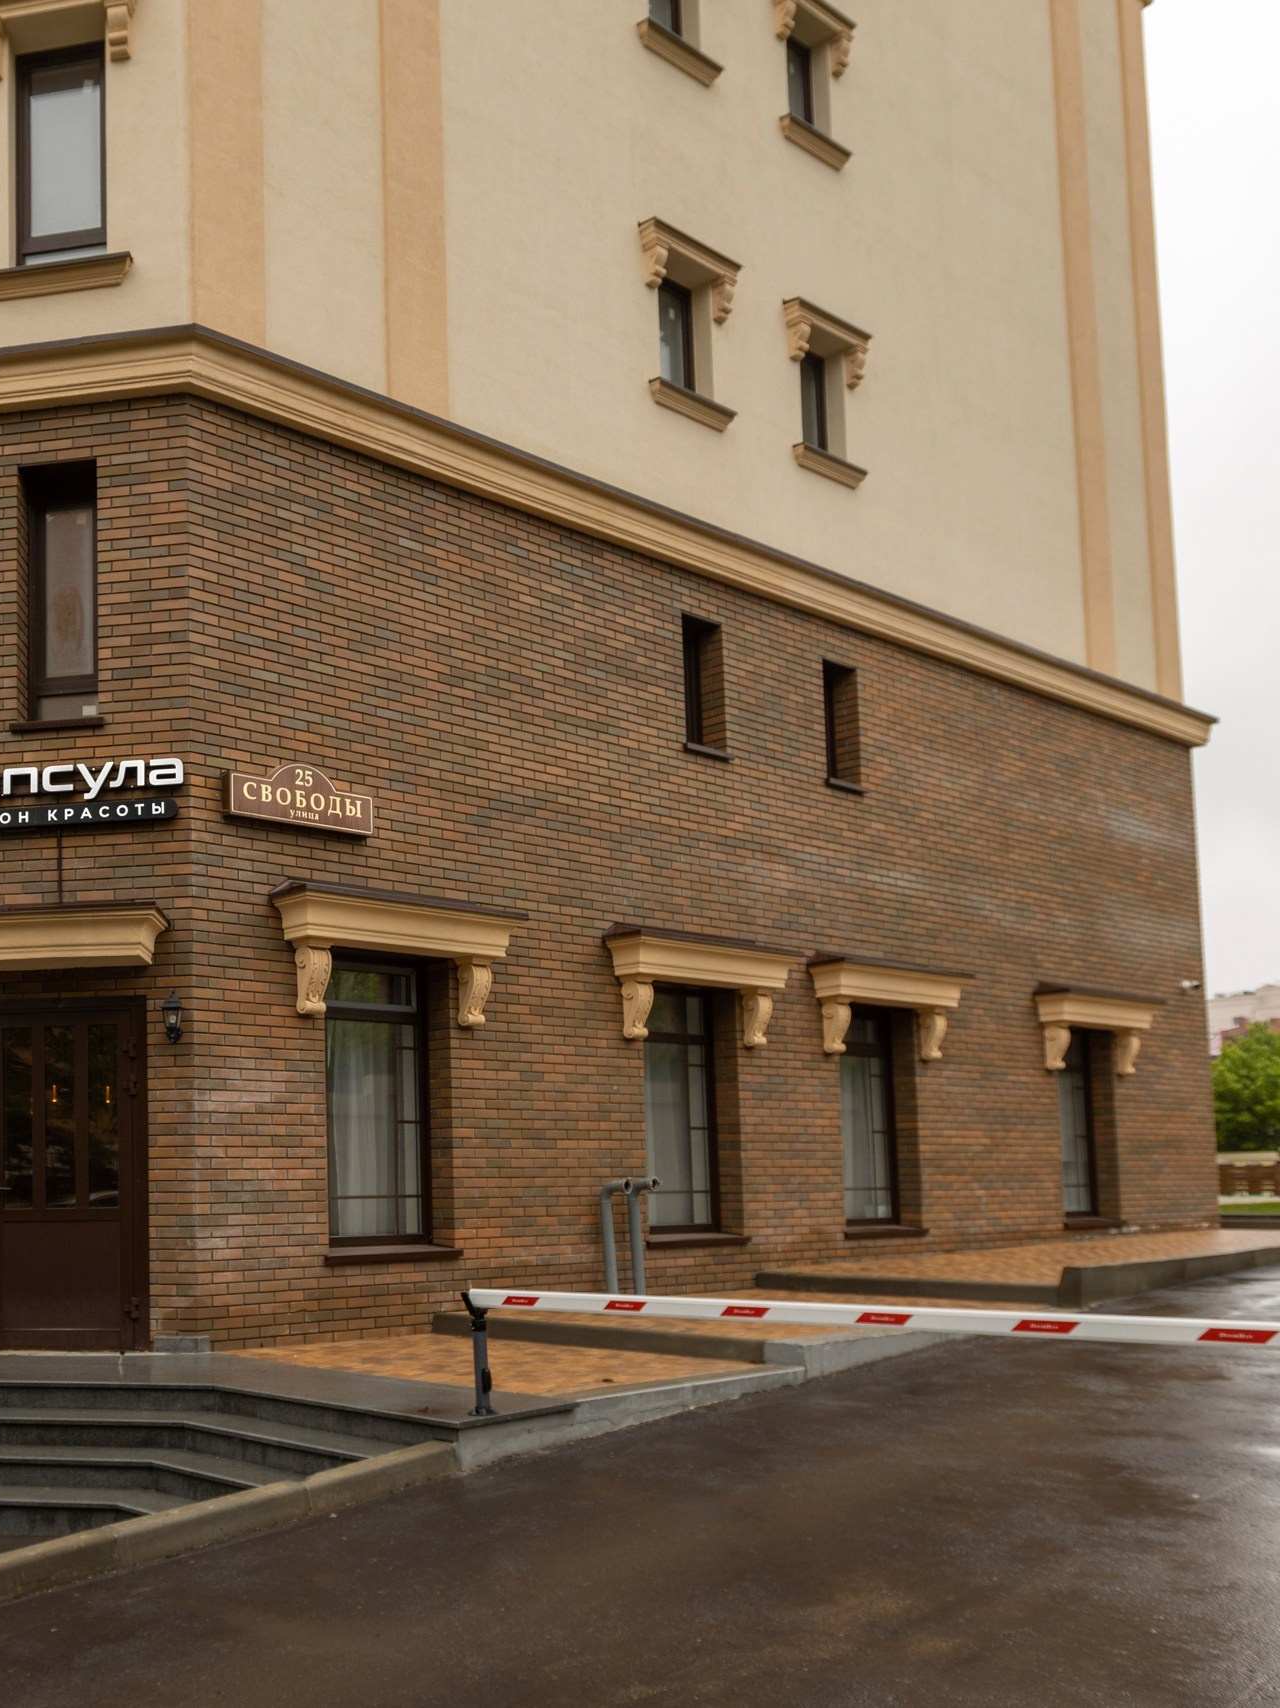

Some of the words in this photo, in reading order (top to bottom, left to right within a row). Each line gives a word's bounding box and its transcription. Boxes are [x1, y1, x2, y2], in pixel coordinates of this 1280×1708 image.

[295, 769, 313, 787] 25
[243, 781, 362, 818] СВОБОДЫ
[47, 801, 165, 821] КРАСОТЫ
[289, 809, 320, 820] улица
